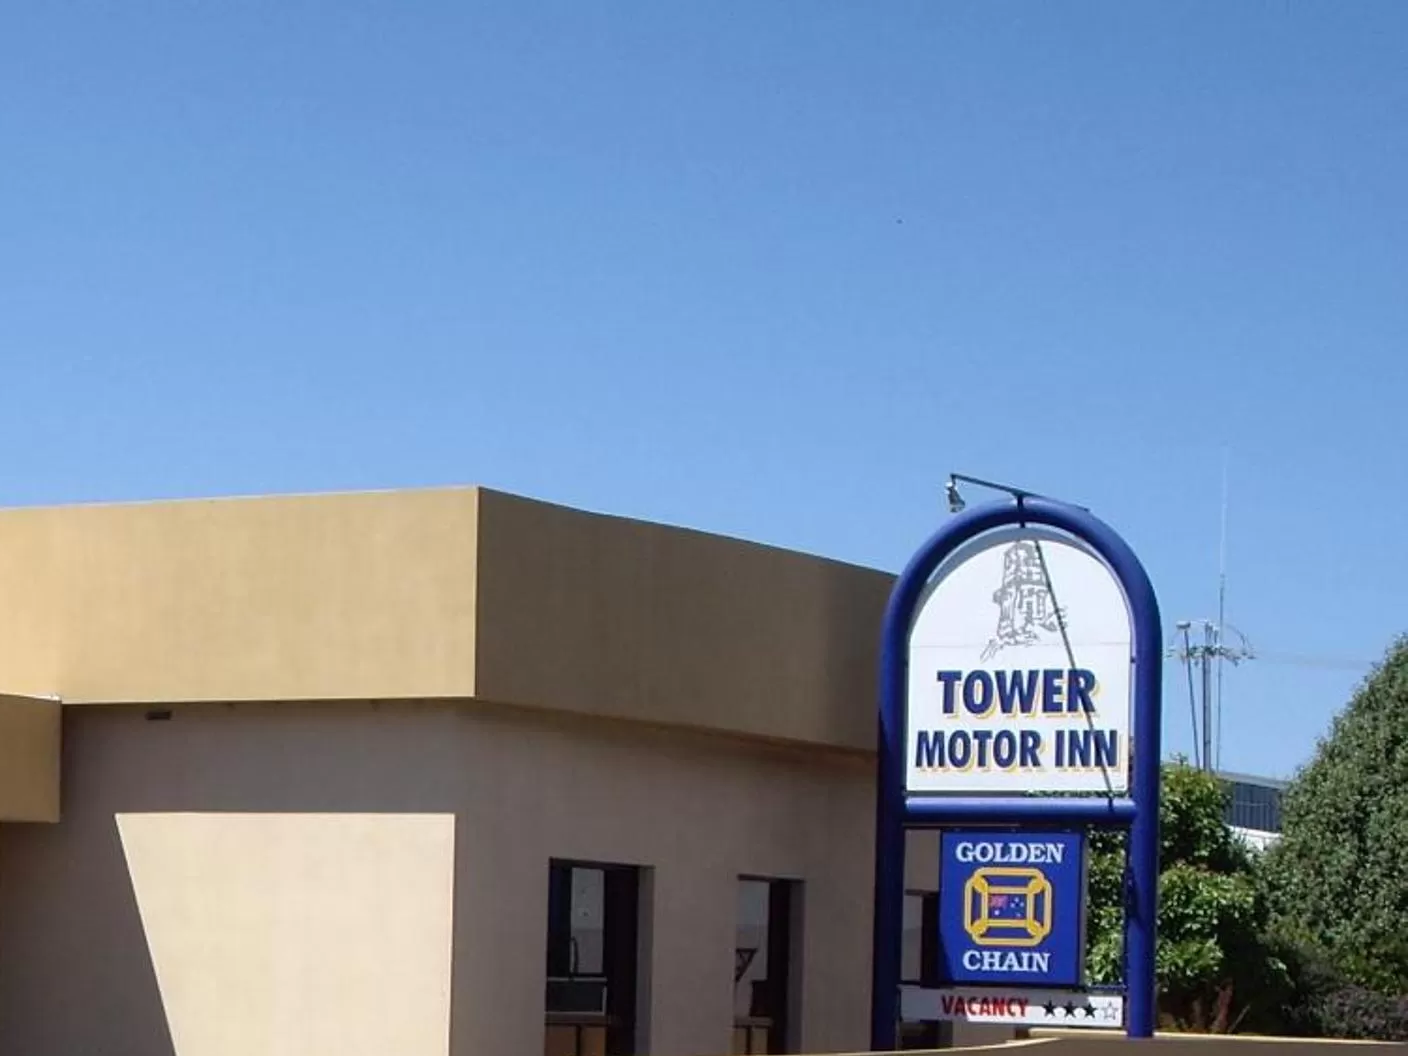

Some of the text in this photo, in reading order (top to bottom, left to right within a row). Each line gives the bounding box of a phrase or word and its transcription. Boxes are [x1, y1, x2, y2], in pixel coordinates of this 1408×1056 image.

[937, 669, 1098, 716] TOWER
[915, 730, 1118, 768] MOTOR INN
[955, 842, 1065, 863] GOLDEN
[962, 950, 1051, 972] CHAIN
[942, 996, 1029, 1017] VACANCY
